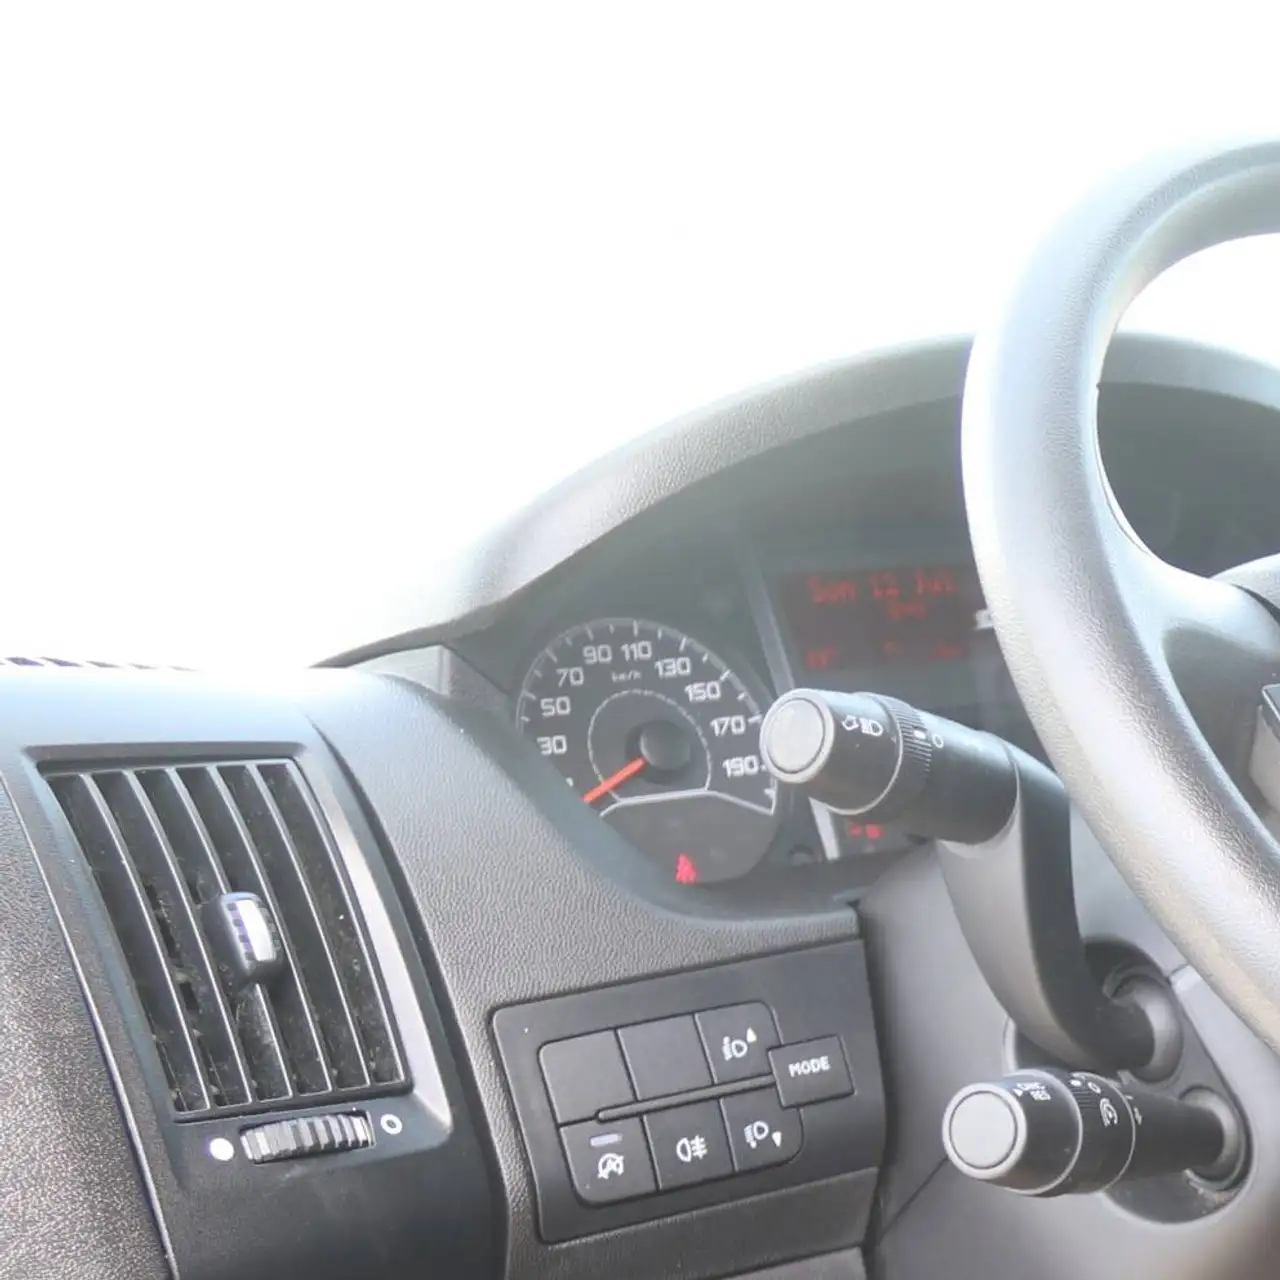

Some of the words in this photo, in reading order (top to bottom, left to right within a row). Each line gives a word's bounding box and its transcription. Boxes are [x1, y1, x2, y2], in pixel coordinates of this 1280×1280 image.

[583, 645, 611, 664] 90
[621, 641, 652, 661] 110
[556, 667, 584, 687] 70
[655, 657, 691, 677] 130
[684, 681, 721, 702] 150
[540, 696, 571, 716] 50
[710, 716, 745, 736] 170
[537, 735, 567, 755] 30
[723, 755, 759, 777] 190
[788, 1056, 830, 1077] MODE
